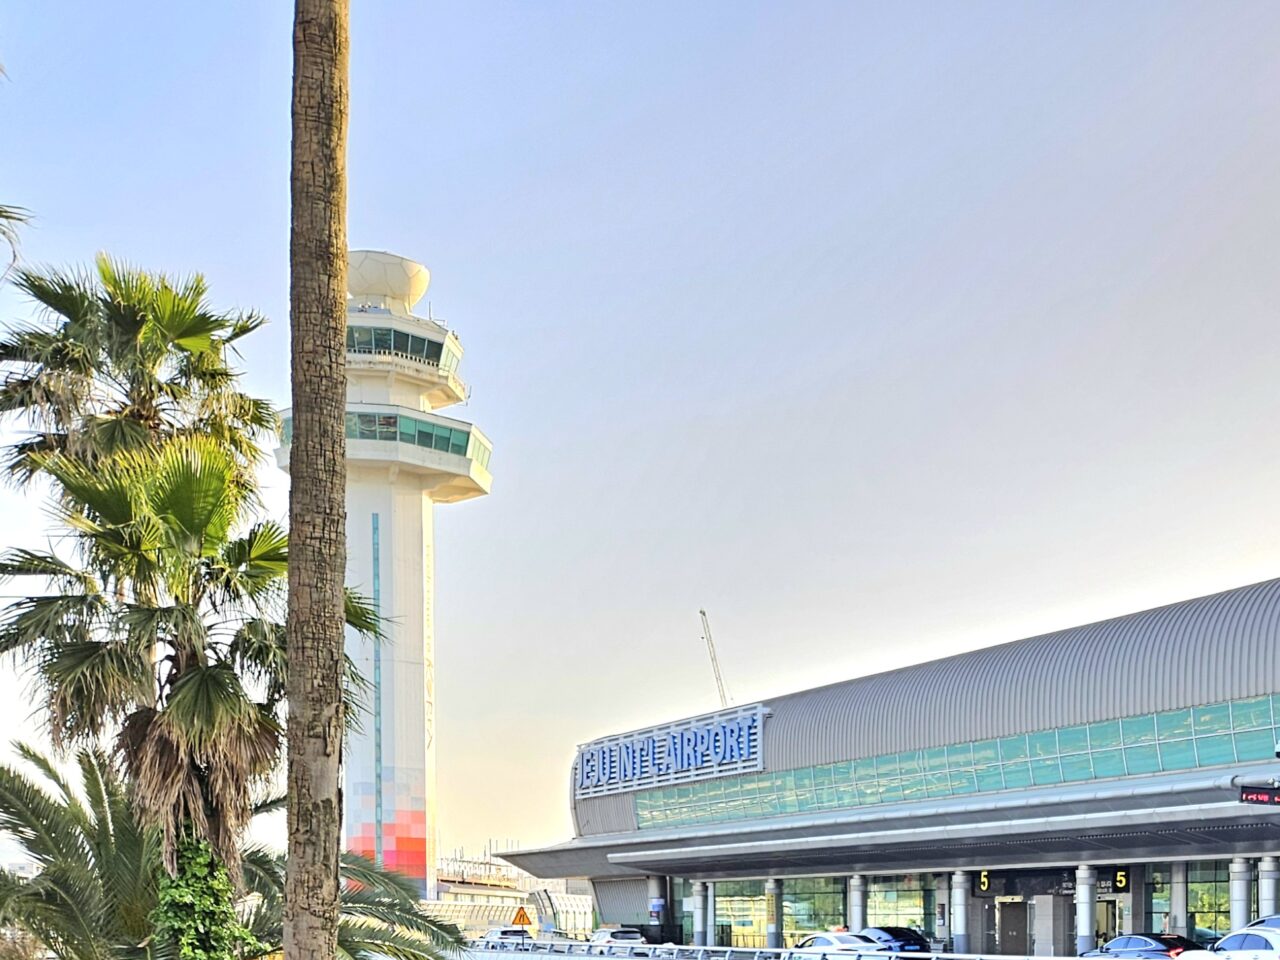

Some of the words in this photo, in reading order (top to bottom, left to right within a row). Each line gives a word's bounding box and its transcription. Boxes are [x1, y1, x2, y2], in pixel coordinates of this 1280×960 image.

[662, 716, 755, 773] AIRPORT
[980, 871, 988, 891] 5
[1116, 871, 1126, 888] 5
